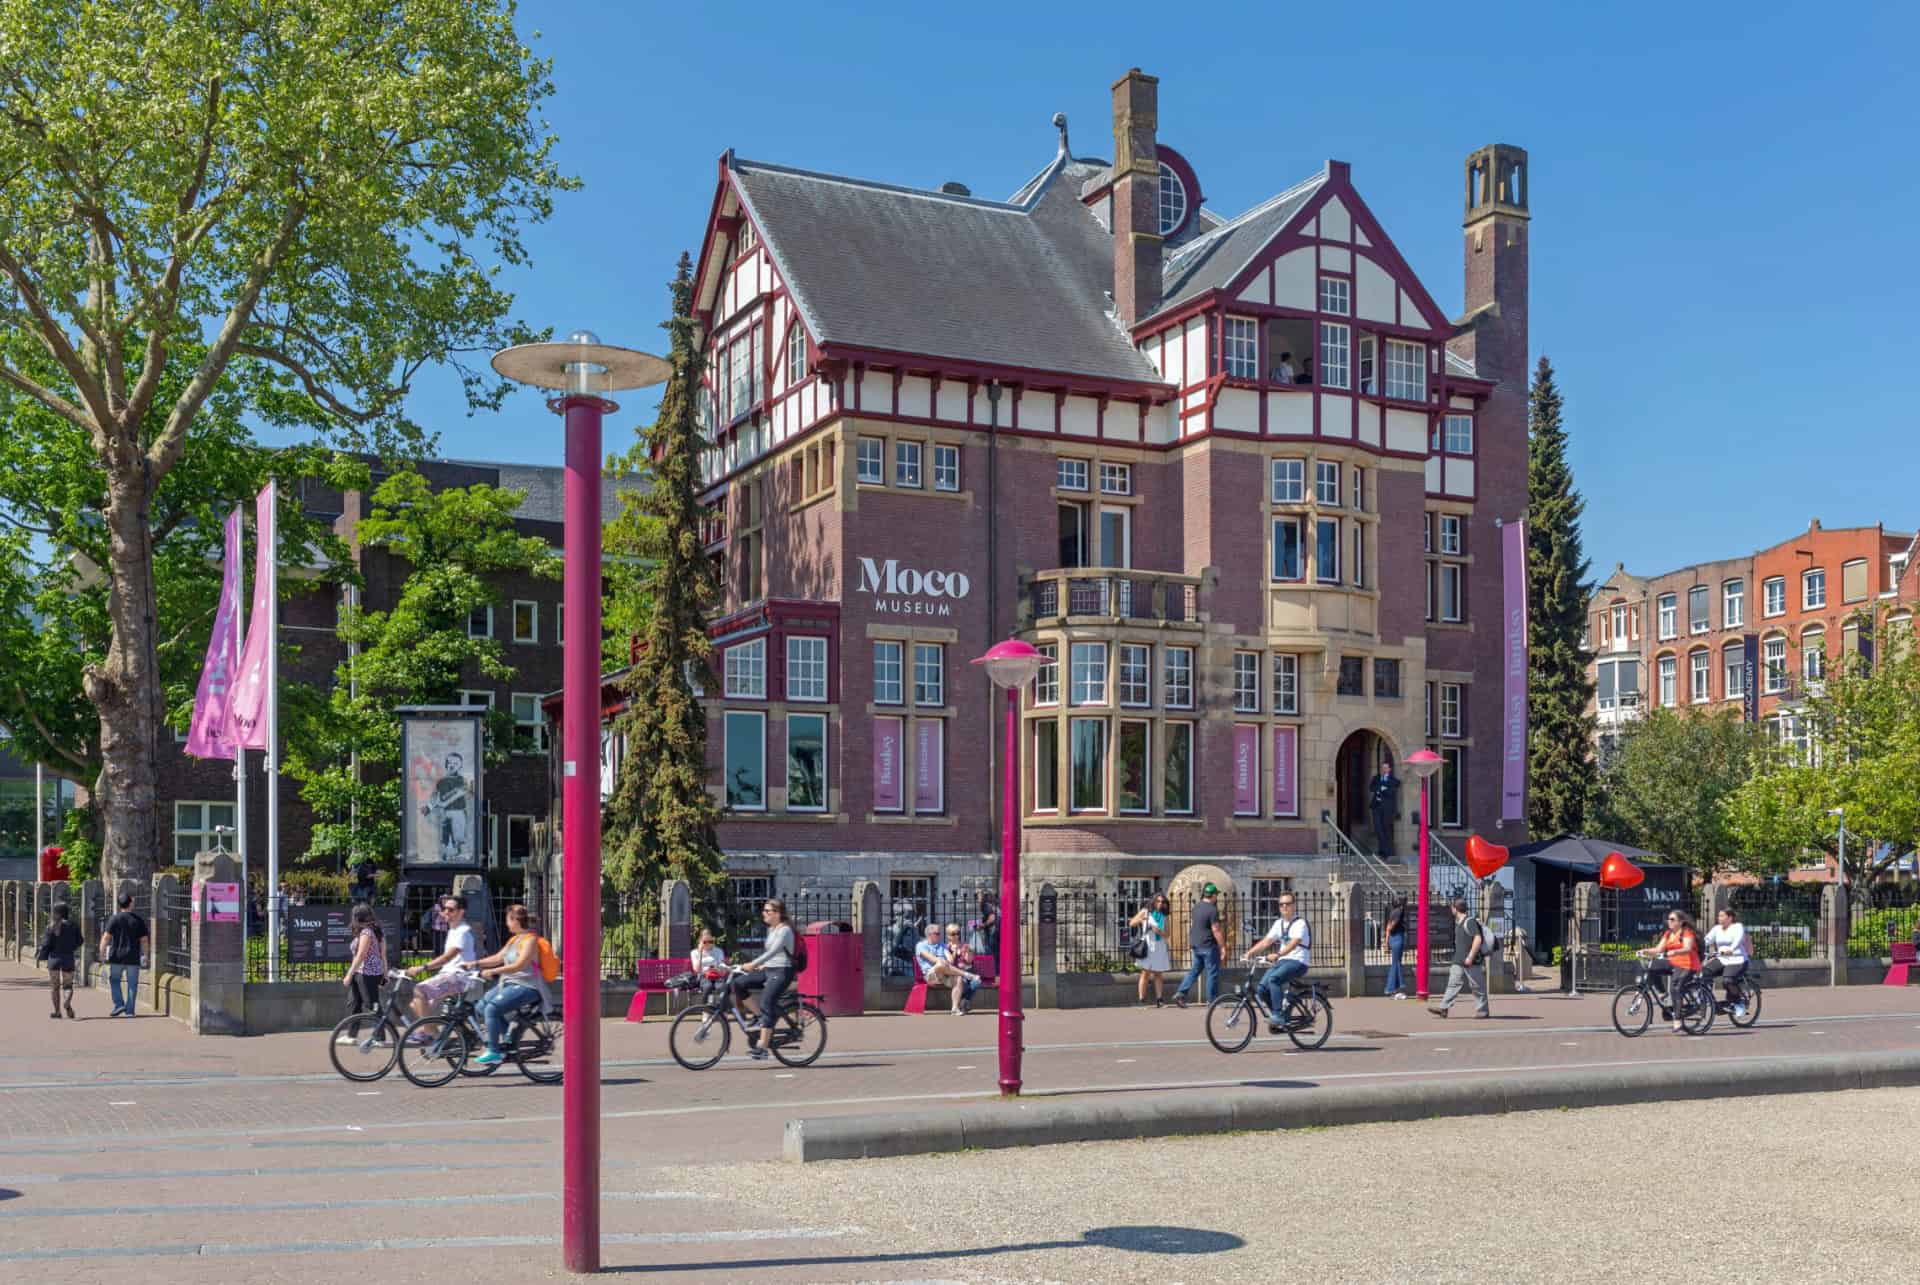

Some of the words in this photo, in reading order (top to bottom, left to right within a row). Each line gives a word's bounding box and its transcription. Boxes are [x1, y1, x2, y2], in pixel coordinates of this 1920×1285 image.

[856, 556, 970, 599] Moco
[875, 599, 950, 617] MUSEUM
[294, 918, 322, 929] Moco
